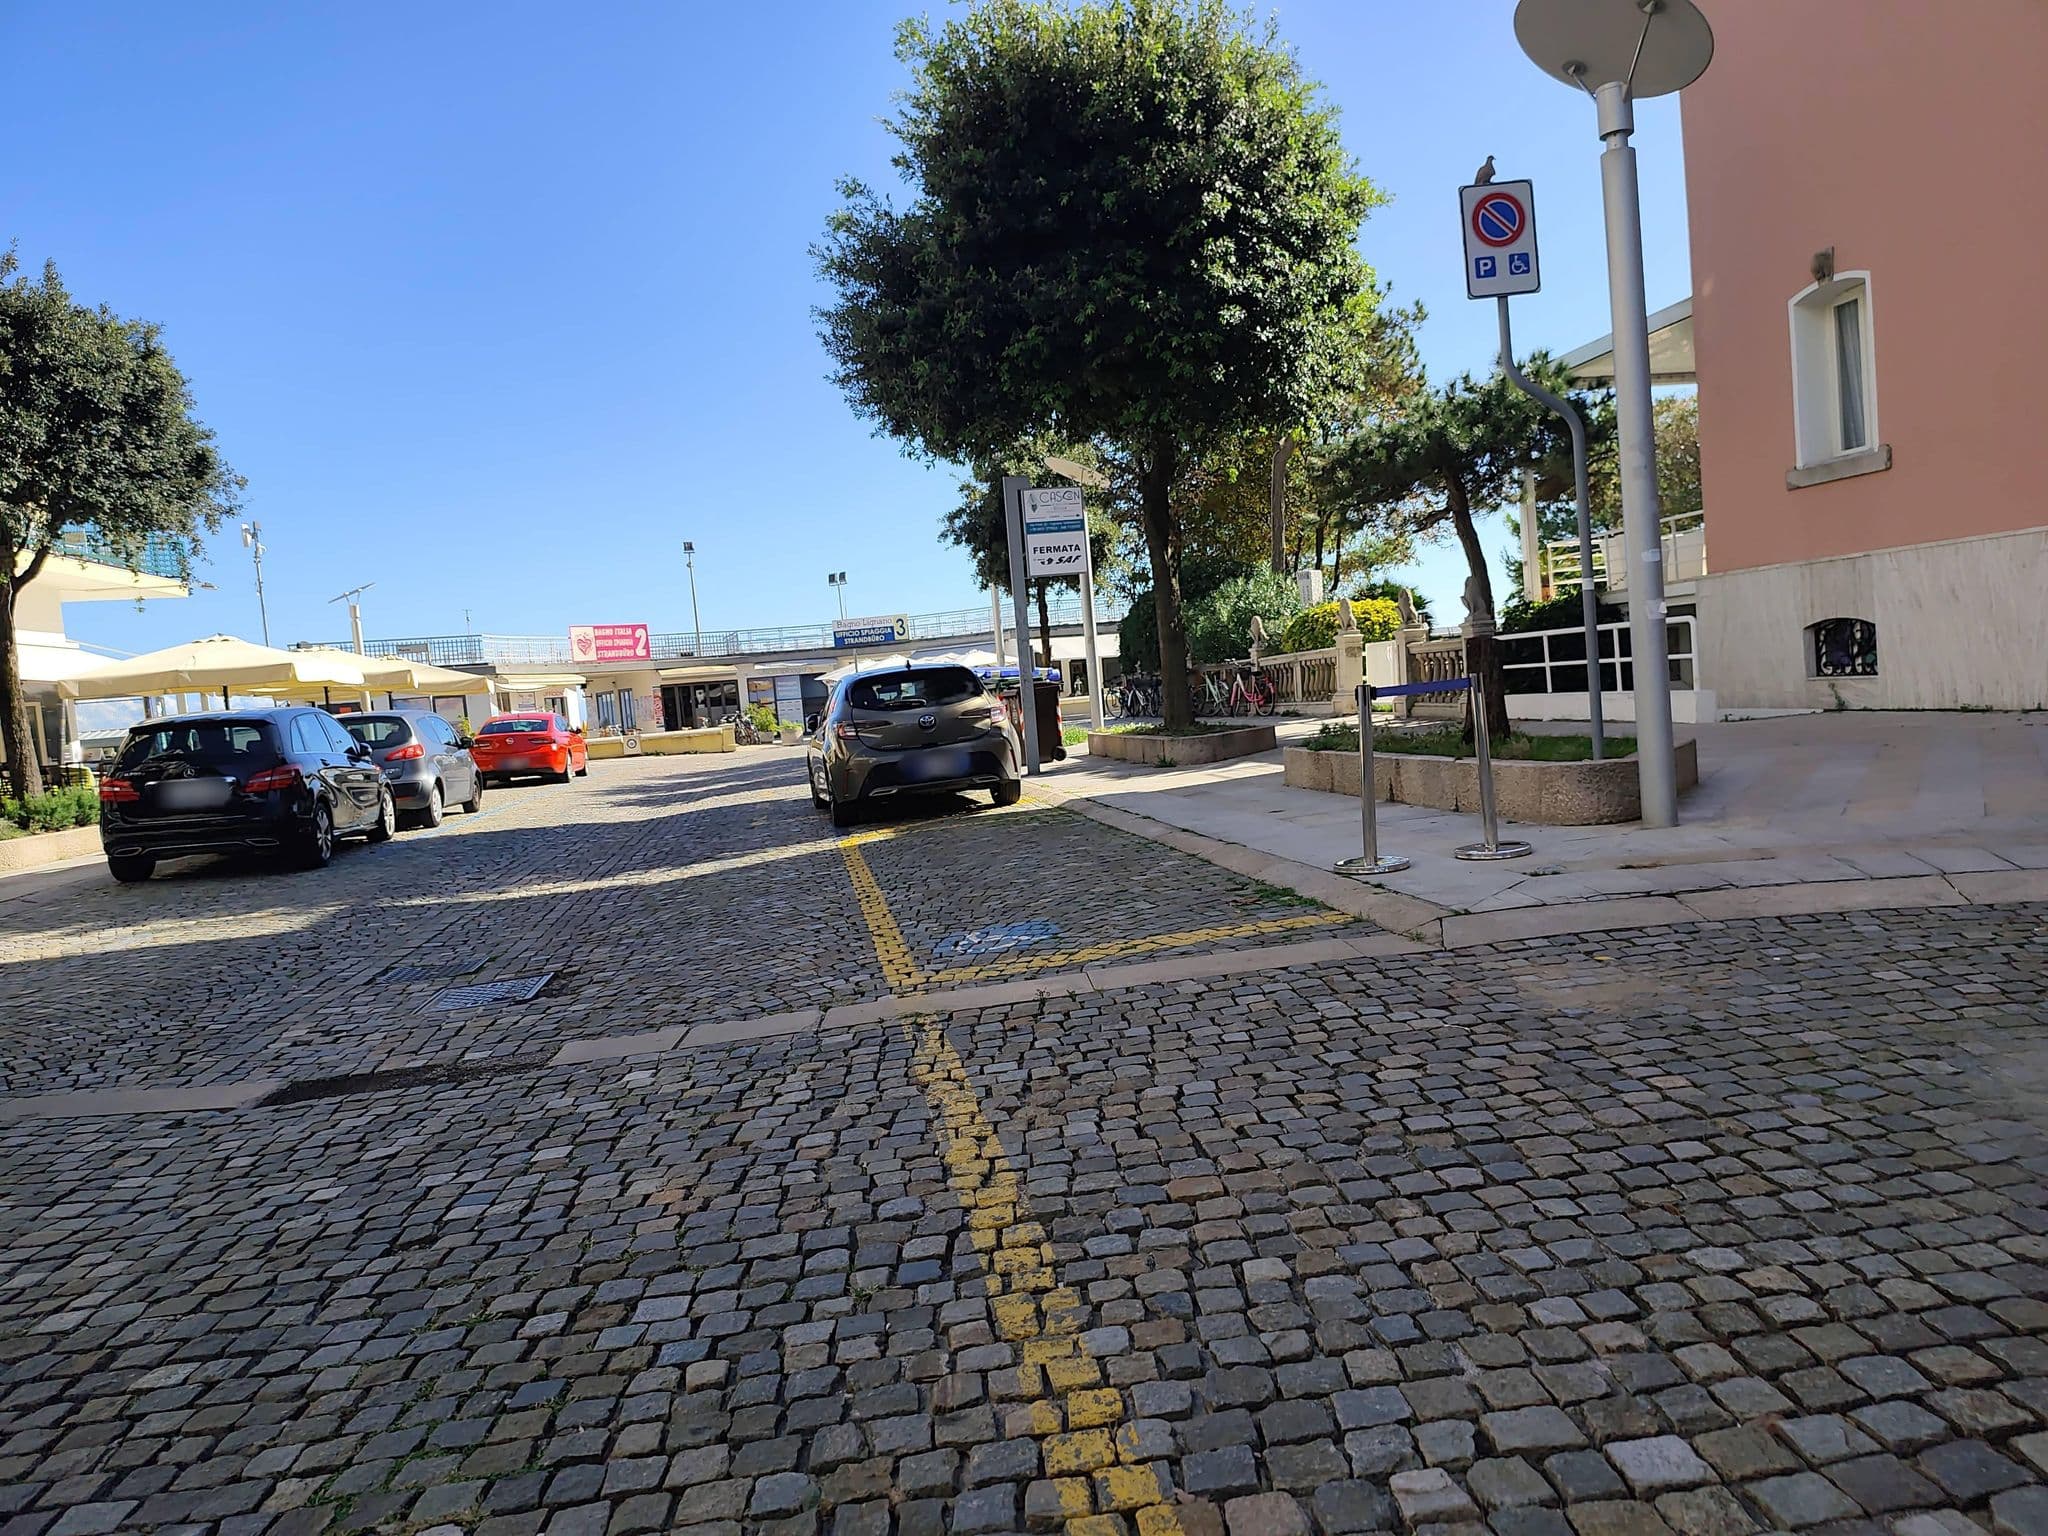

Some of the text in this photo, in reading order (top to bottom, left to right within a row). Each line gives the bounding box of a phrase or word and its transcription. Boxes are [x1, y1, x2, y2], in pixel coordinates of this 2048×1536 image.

[1479, 259, 1492, 276] P
[1033, 544, 1081, 554] FERMATA
[1056, 555, 1082, 564] SAF
[837, 620, 860, 629] Bagno
[896, 618, 906, 636] 3
[861, 627, 892, 636] SPIAGGIA
[635, 628, 647, 656] 2
